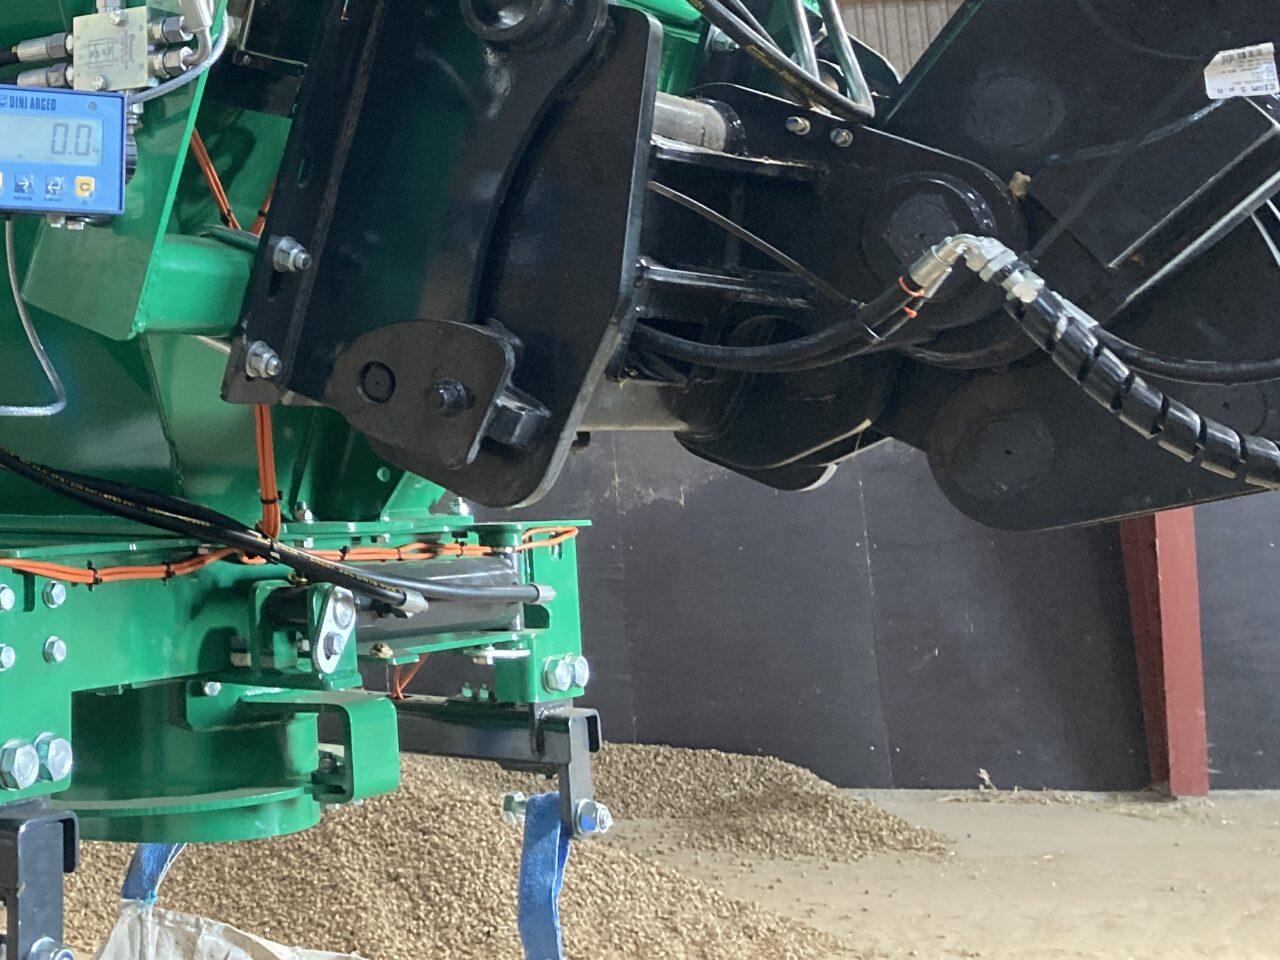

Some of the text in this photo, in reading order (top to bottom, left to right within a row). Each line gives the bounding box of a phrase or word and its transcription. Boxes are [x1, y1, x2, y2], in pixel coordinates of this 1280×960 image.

[9, 95, 57, 111] DINI ARGEO
[51, 122, 92, 157] 0.0
